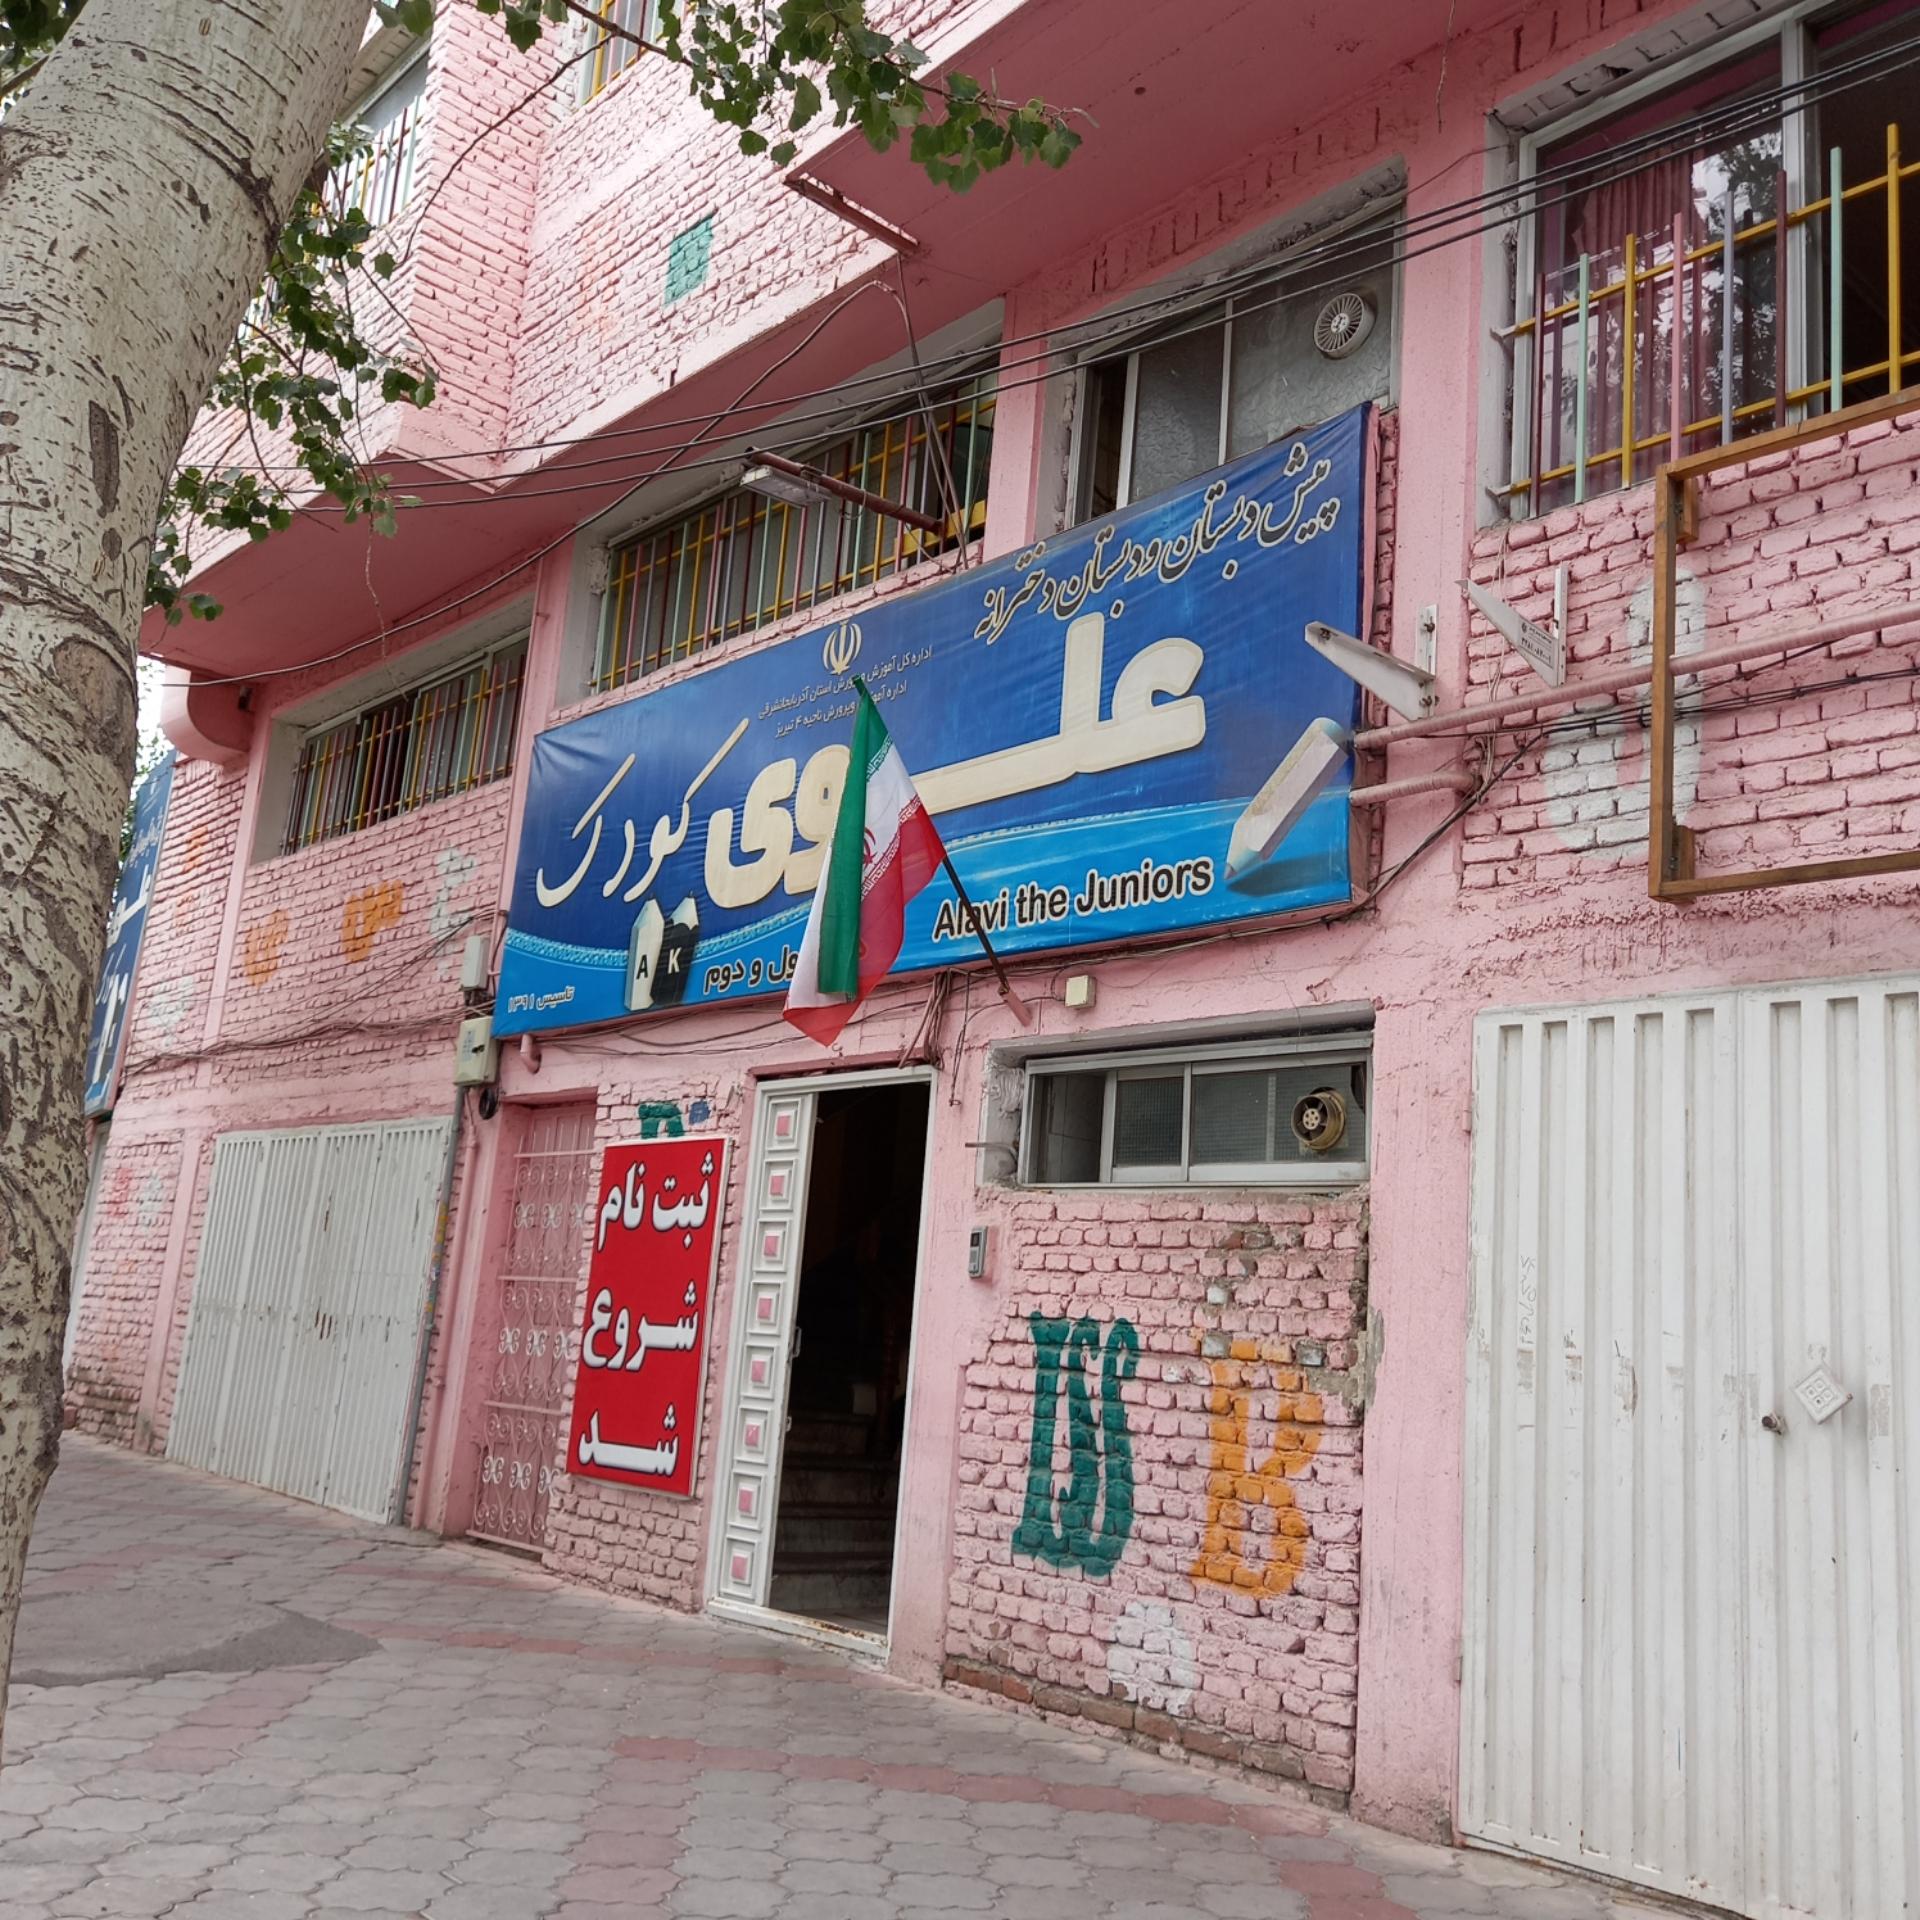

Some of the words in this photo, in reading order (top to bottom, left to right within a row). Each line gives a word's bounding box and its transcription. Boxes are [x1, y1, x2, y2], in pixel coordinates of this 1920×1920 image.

[1158, 480, 1261, 584] دبستان
[1257, 442, 1341, 548] پیش
[973, 542, 1058, 646] دخترانه
[1053, 525, 1144, 620] دبستان
[932, 886, 1008, 943] Alavi
[1014, 881, 1069, 927] the
[1074, 856, 1215, 917] Juniors
[635, 953, 650, 981] A
[667, 947, 682, 975] K
[703, 958, 745, 995] دوم
[750, 962, 763, 988] و
[767, 944, 800, 982] ول
[597, 1161, 648, 1252] نام
[651, 1152, 715, 1249] ثبت
[581, 1280, 698, 1371] شروع
[577, 1402, 679, 1477] شد
